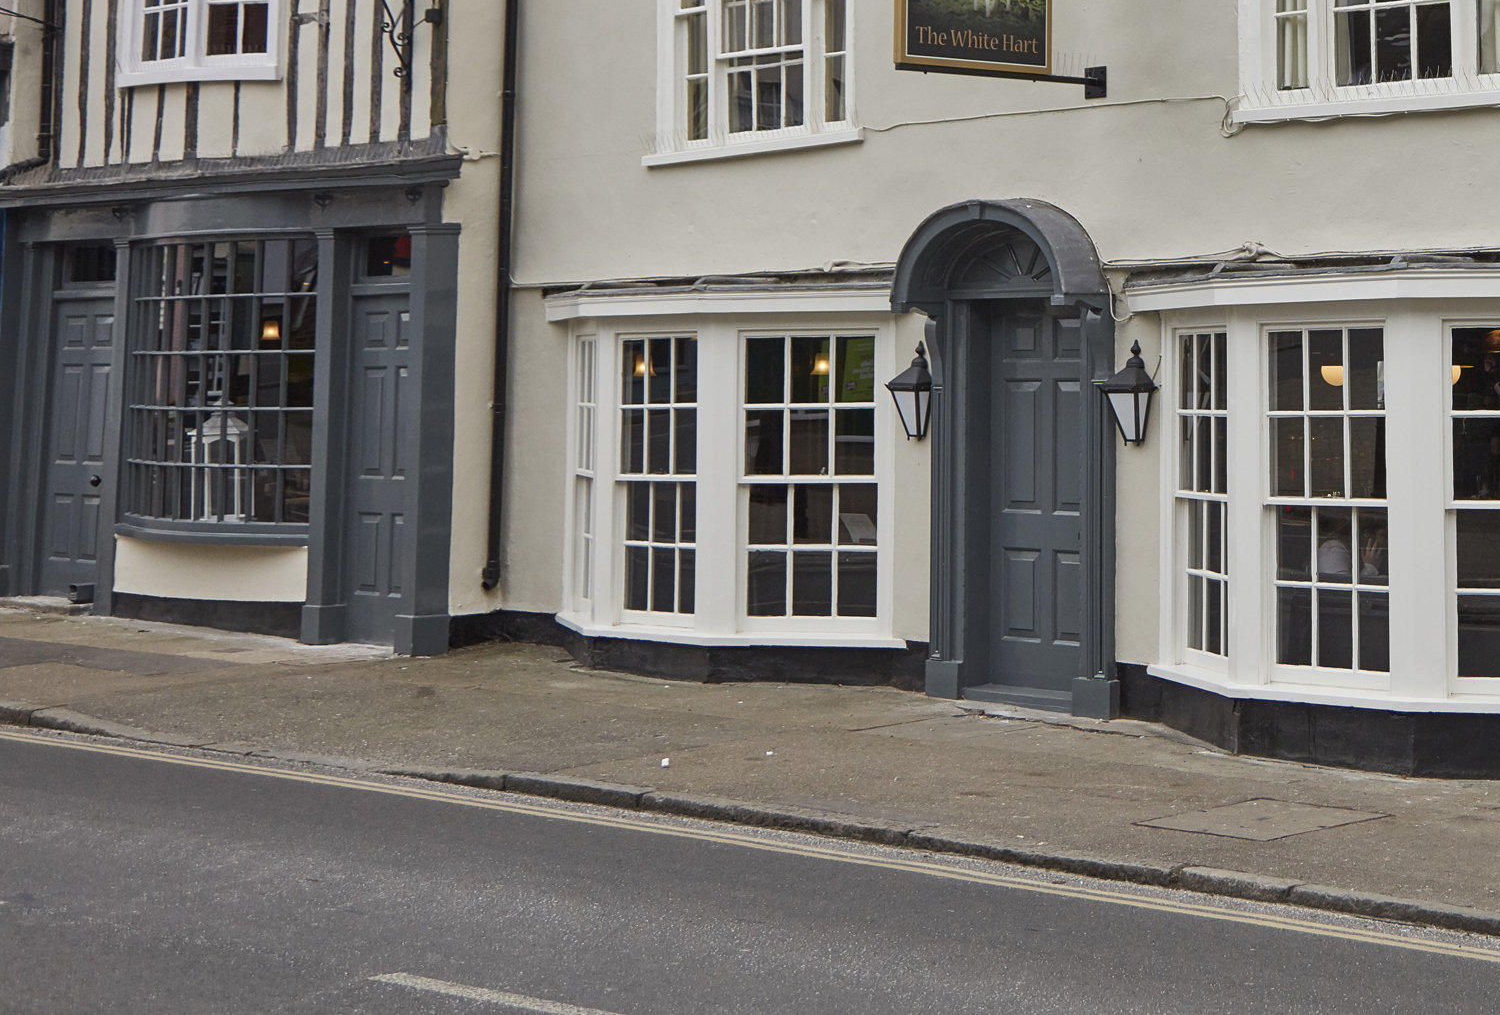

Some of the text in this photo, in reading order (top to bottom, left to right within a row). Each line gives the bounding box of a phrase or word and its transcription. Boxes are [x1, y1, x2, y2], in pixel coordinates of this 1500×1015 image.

[915, 25, 1039, 54] The White Hart
